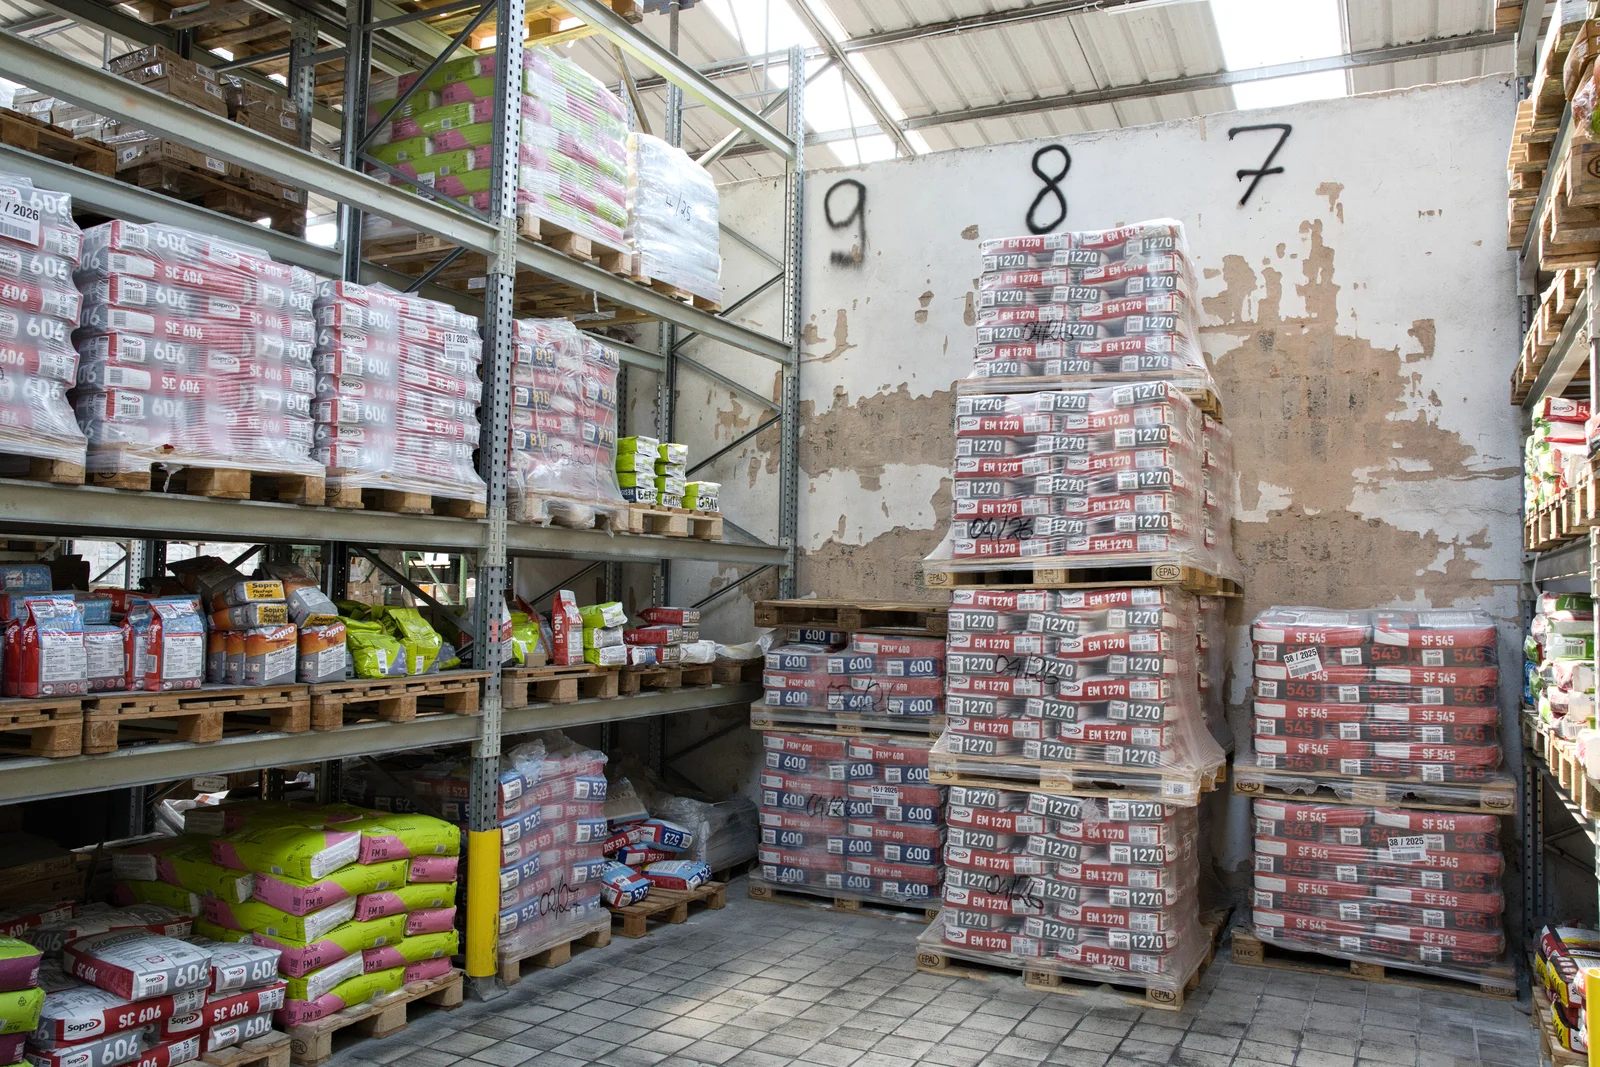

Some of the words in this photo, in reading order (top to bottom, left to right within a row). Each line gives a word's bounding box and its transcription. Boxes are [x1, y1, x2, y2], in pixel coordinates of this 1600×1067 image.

[1228, 124, 1292, 204] 7
[1026, 144, 1070, 233] 8
[30, 191, 69, 216] 606
[13, 205, 39, 222] 2026
[824, 179, 866, 268] 9
[156, 231, 190, 251] 606
[1144, 237, 1172, 249] 1270
[30, 256, 67, 279] 606
[165, 266, 180, 280] SC
[183, 270, 203, 285] 606
[1006, 275, 1018, 283] EM
[1019, 274, 1038, 283] 1270
[1146, 276, 1173, 288] 1270
[2, 283, 28, 302] 606
[997, 290, 1023, 302] 1270
[1070, 288, 1097, 300] 1270
[368, 311, 390, 329] 606
[1146, 316, 1173, 329] 1270
[27, 317, 65, 341] 606
[123, 338, 138, 346] Sopro
[446, 334, 452, 342] 18
[456, 335, 468, 344] 2026
[1106, 342, 1118, 351] EM
[1120, 340, 1141, 350] 1270
[250, 365, 262, 378] SC
[265, 367, 282, 381] 606
[368, 359, 390, 376] 606
[341, 380, 359, 389] Sopro
[1135, 384, 1165, 397] 1270
[533, 391, 550, 405] 810
[365, 406, 387, 423] 606
[1552, 405, 1570, 413] Sopro
[1093, 418, 1106, 428] EM
[1108, 414, 1129, 425] 1270
[446, 424, 458, 434] 606
[530, 432, 548, 447] 810
[1094, 458, 1106, 468] EM
[1109, 455, 1131, 466] 1270
[1139, 471, 1170, 485] 1270
[1138, 514, 1169, 529] 1270
[1094, 540, 1107, 550] EM
[1109, 538, 1132, 550] 1270
[1159, 567, 1176, 576] EPAL
[1089, 595, 1103, 605] EM
[1105, 591, 1127, 603] 1270
[690, 611, 700, 620] 400
[554, 615, 563, 640] No.1
[1045, 617, 1075, 633] 1270
[266, 626, 294, 641] Sopro
[318, 625, 344, 640] Sopro
[687, 631, 698, 640] 400
[805, 630, 825, 641] 600
[1296, 632, 1307, 642] SF
[1309, 633, 1325, 643] 545
[1421, 635, 1433, 645] SF
[1435, 636, 1454, 646] 545
[1284, 654, 1294, 664] 38
[1300, 649, 1317, 660] 2025
[1371, 646, 1400, 660] 545
[849, 658, 872, 670] 600
[909, 661, 932, 673] 600
[1423, 672, 1435, 683] SF
[1438, 672, 1456, 683] 545
[974, 680, 987, 690] EM
[988, 680, 1009, 692] 1270
[1061, 684, 1081, 692] Sopro
[1087, 685, 1101, 695] EM
[1103, 684, 1125, 695] 1270
[1286, 683, 1315, 697] 545
[909, 700, 932, 712] 600
[1297, 707, 1308, 717] SF
[1310, 708, 1327, 718] 545
[1042, 744, 1072, 760] 1270
[784, 757, 806, 769] 600
[850, 764, 873, 776] 600
[525, 813, 540, 831] 523
[976, 815, 988, 826] EM
[990, 817, 1011, 829] 1270
[1297, 811, 1308, 821] SF
[1310, 812, 1326, 823] 545
[604, 840, 614, 851] DSF
[615, 838, 626, 847] 523
[665, 833, 680, 844] 523
[781, 832, 802, 844] 600
[1389, 838, 1398, 846] 38
[1405, 837, 1424, 846] 2025
[372, 849, 381, 857] FM
[382, 848, 387, 856] 10
[505, 850, 520, 858] Sopro
[525, 838, 538, 852] DSF
[539, 834, 550, 846] 523
[1046, 842, 1077, 860] 1270
[906, 848, 930, 860] 600
[523, 858, 540, 877] 523
[847, 876, 870, 888] 600
[635, 886, 649, 900] 523
[306, 898, 316, 907] FM
[317, 896, 323, 905] 10
[1086, 912, 1100, 923] EM
[1102, 913, 1124, 925] 1270
[1044, 923, 1074, 940] 1270
[921, 956, 937, 965] EPAL
[1086, 952, 1100, 963] EM
[1102, 954, 1124, 967] 1270
[77, 963, 86, 974] SC
[87, 968, 96, 982] 606
[145, 974, 164, 983] Sopro
[174, 962, 207, 987] 606
[188, 990, 195, 999] 25
[1154, 989, 1173, 1000] EPAL
[67, 1018, 100, 1032] Sopro
[118, 1012, 136, 1027] SC
[139, 1005, 161, 1022] 606
[244, 1014, 271, 1038] 606
